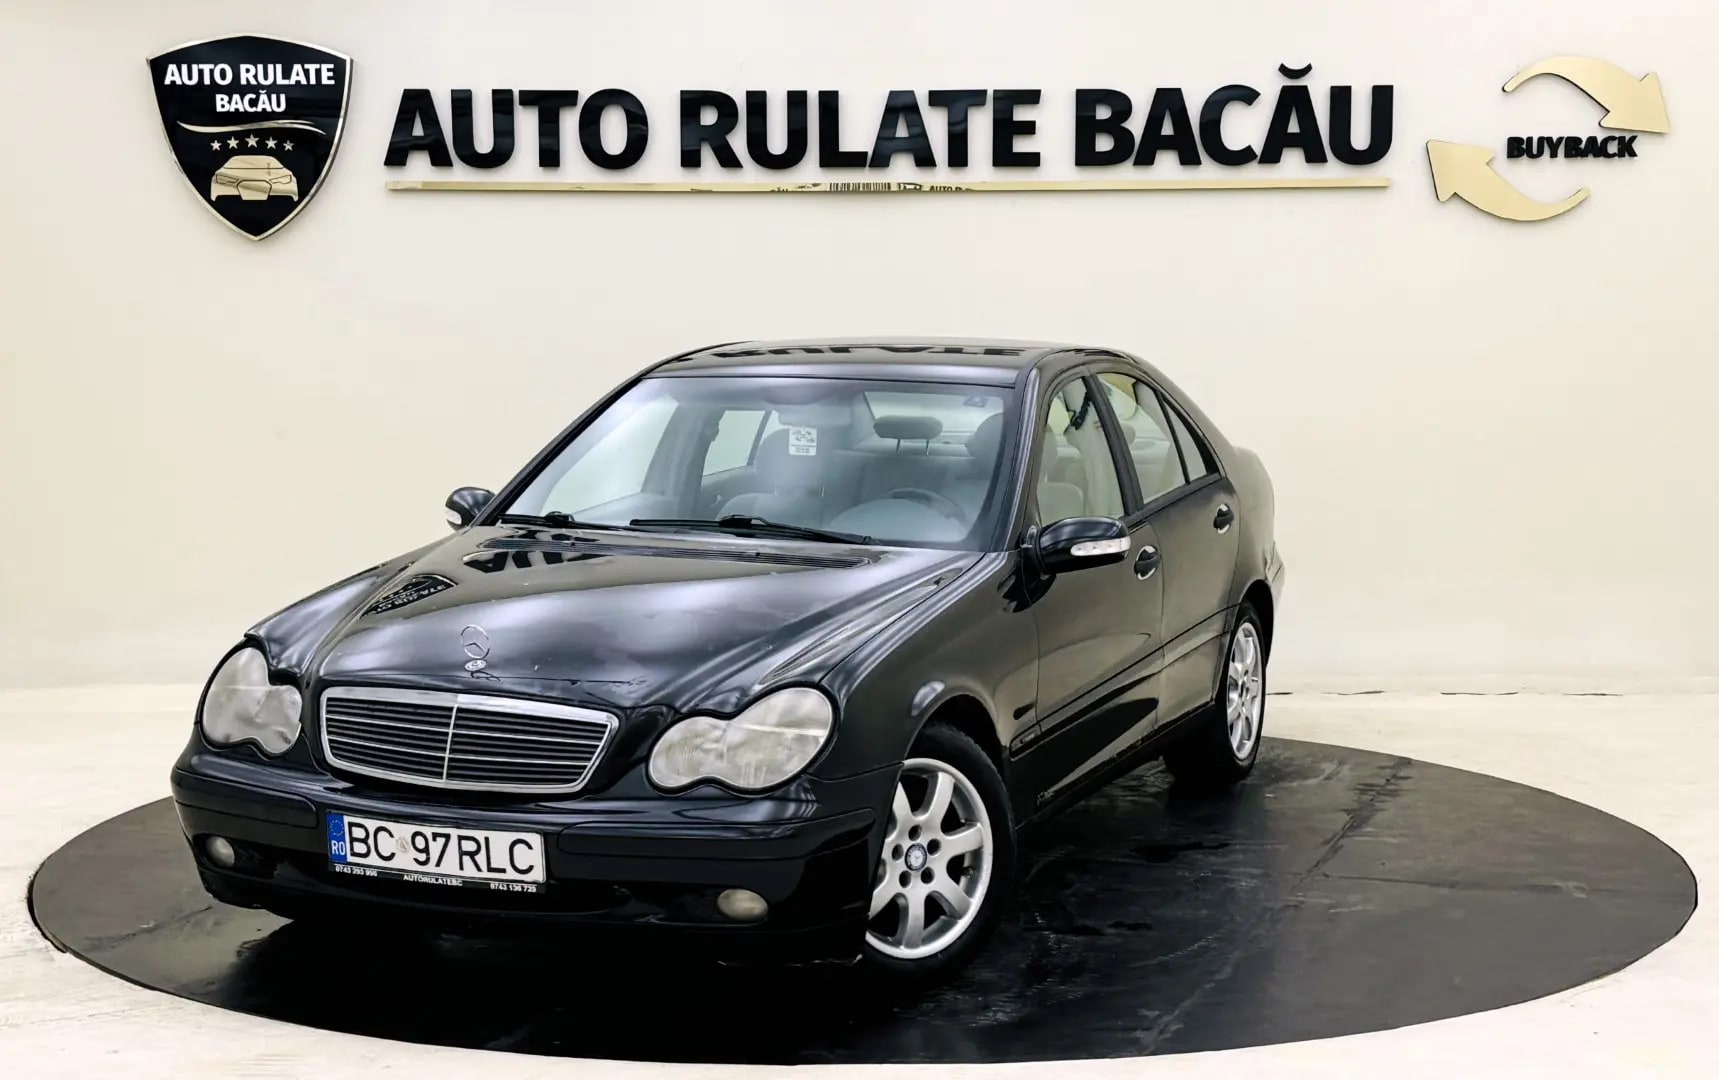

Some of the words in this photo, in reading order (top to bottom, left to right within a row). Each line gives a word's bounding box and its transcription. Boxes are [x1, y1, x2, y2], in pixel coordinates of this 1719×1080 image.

[164, 63, 233, 86] AUTO
[240, 63, 335, 85] RULATE
[215, 89, 287, 112] BACĂU
[384, 88, 650, 169] AUTO
[679, 88, 1042, 169] RULATE
[1075, 62, 1394, 167] BACĂU
[1506, 135, 1638, 159] BUYBACK
[331, 840, 346, 857] RO
[348, 821, 397, 862] BC
[410, 830, 452, 867] 97
[456, 834, 536, 876] RLC
